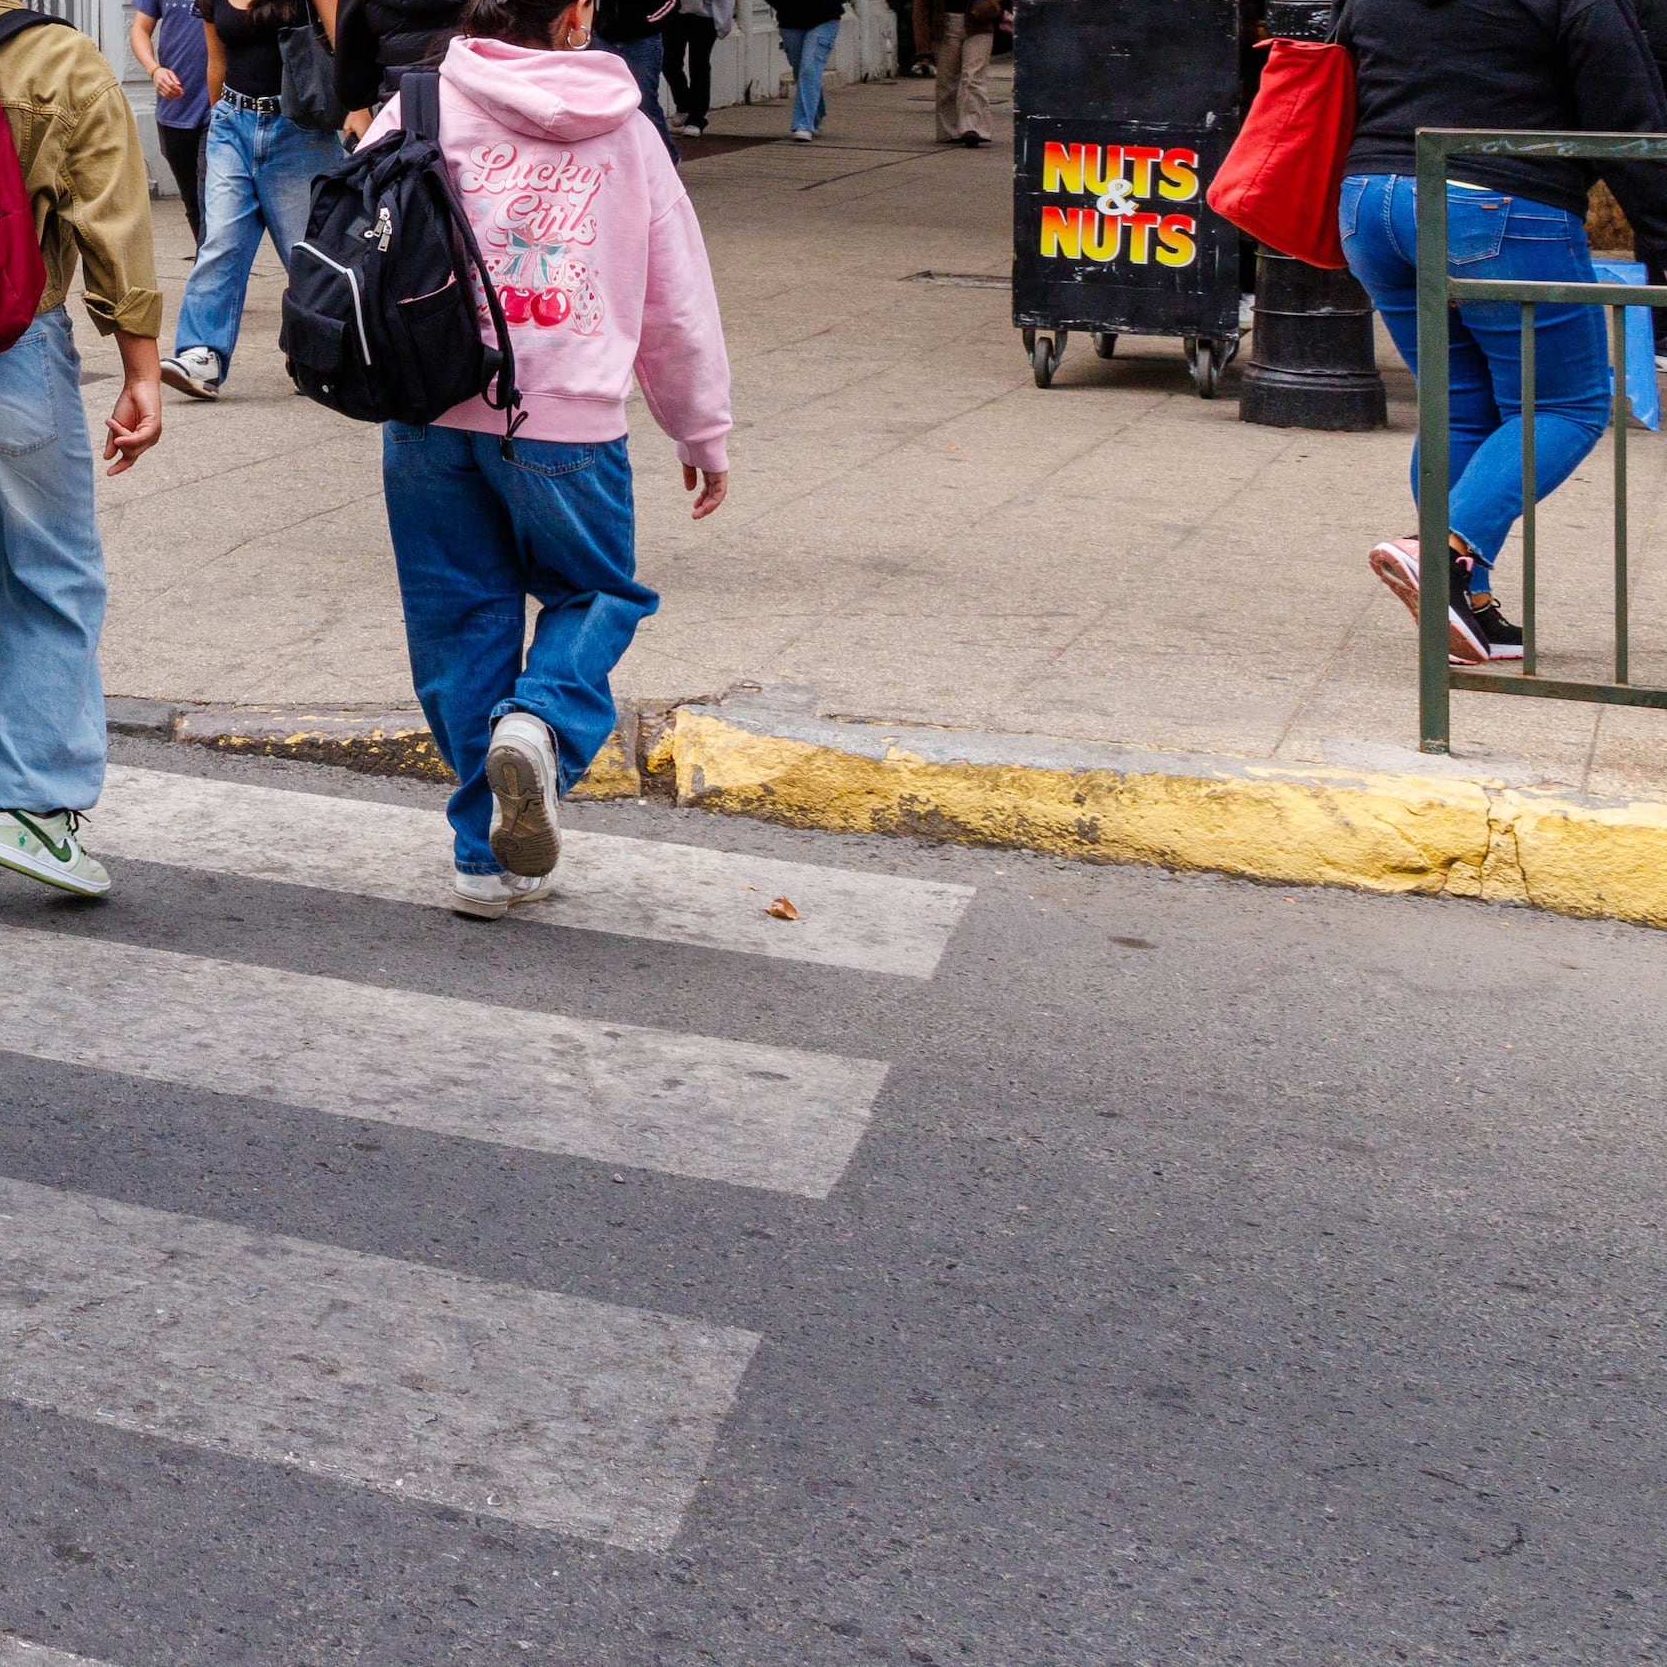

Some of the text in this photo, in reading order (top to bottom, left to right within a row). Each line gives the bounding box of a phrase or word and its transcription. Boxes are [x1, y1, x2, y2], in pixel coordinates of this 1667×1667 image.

[460, 143, 602, 198] Lucky
[1042, 141, 1199, 202] NUTS
[1096, 178, 1140, 217] &
[486, 193, 598, 247] Girls
[1040, 205, 1197, 268] NUTS
